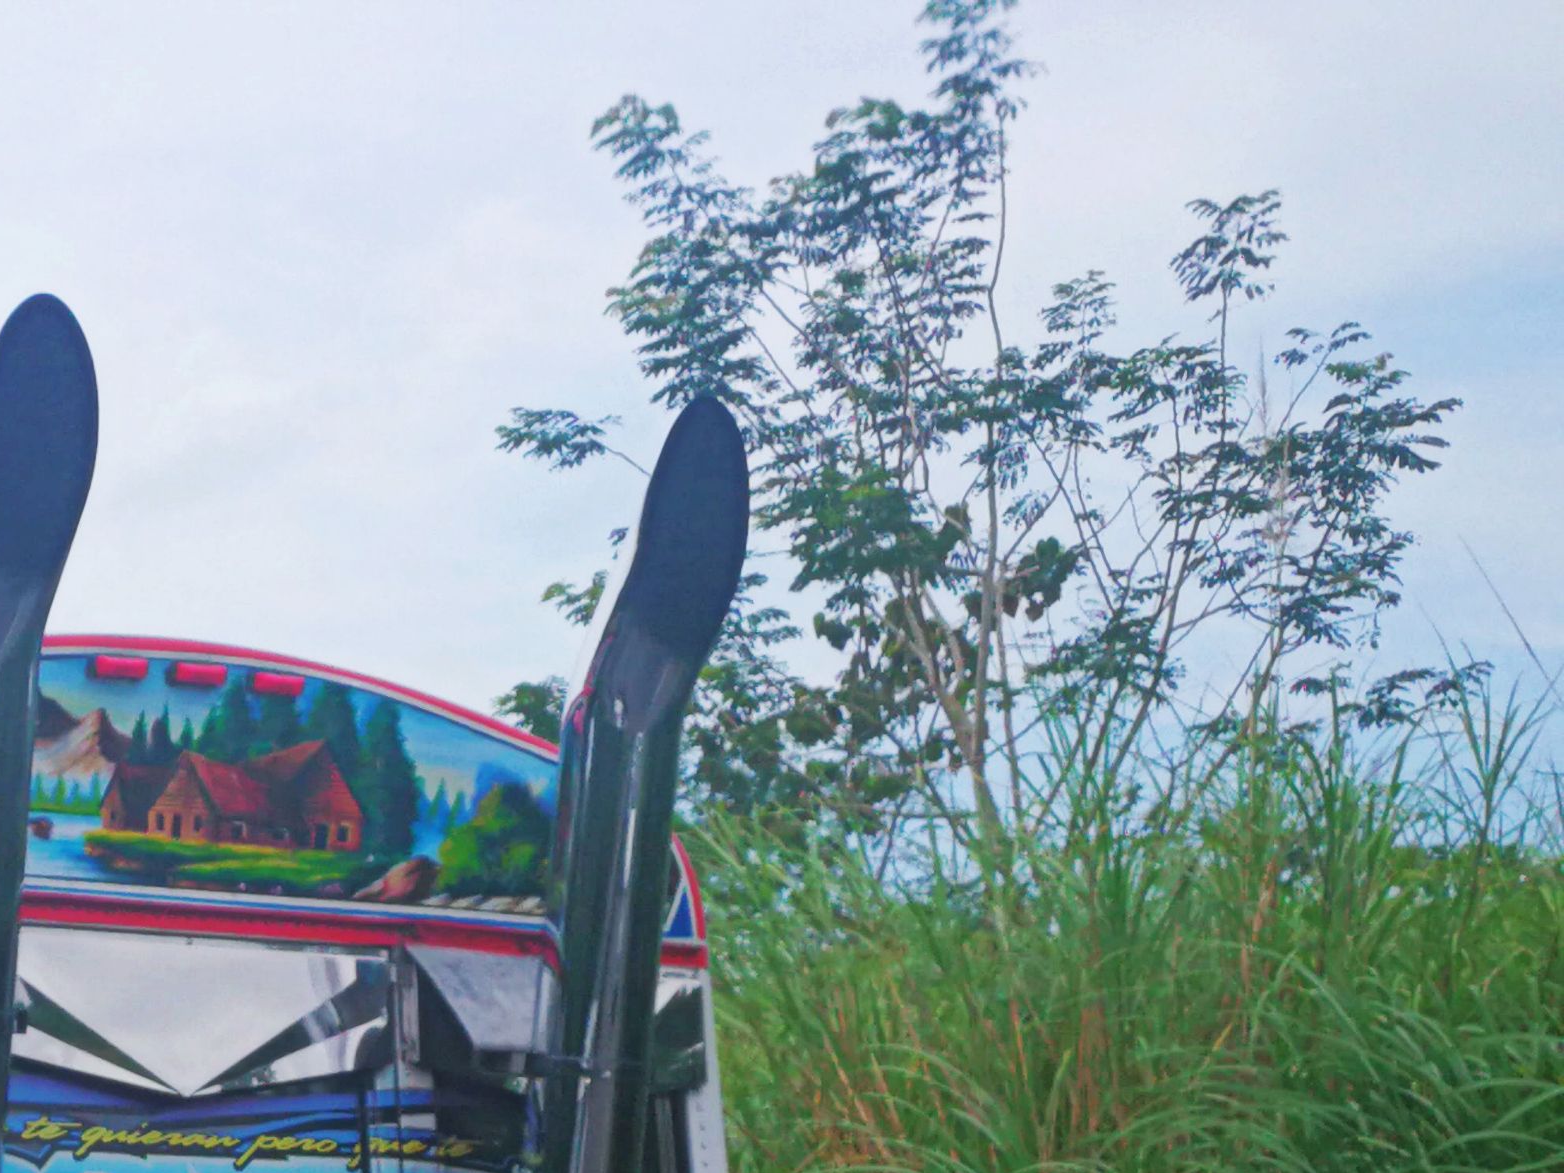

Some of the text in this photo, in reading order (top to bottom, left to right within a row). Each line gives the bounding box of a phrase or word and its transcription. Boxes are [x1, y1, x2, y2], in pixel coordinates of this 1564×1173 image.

[21, 1115, 82, 1139] te
[72, 1121, 241, 1161] quieran
[233, 1134, 337, 1170] pero
